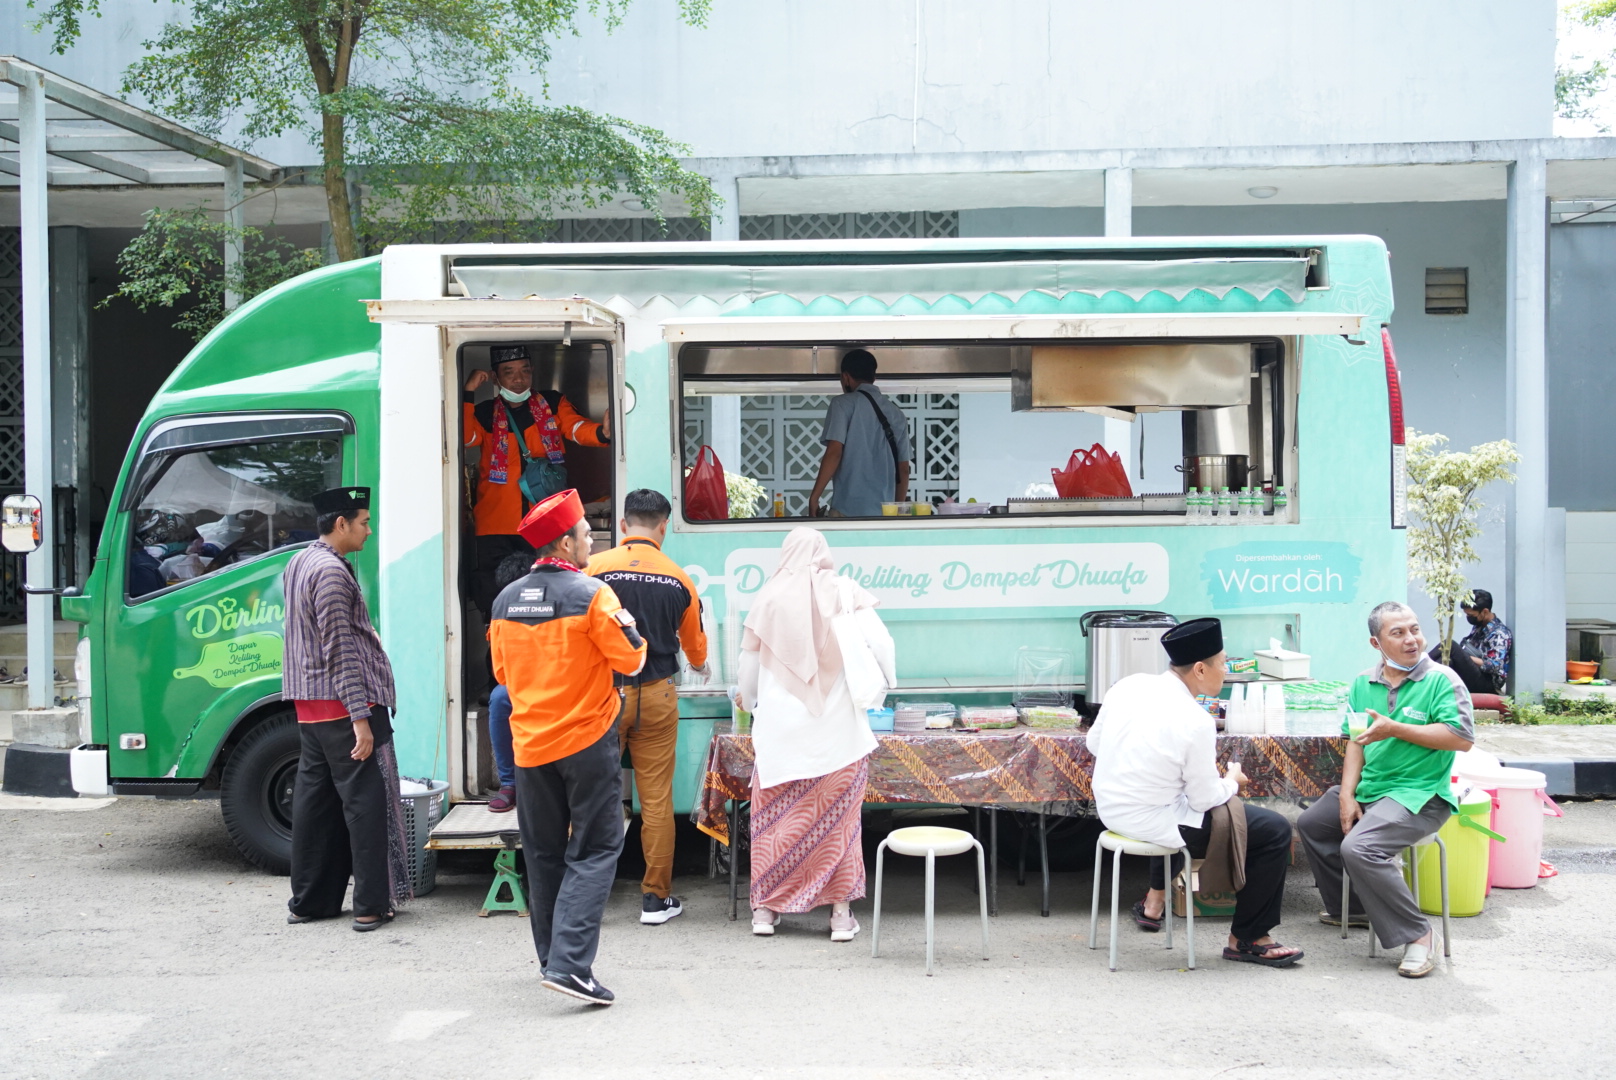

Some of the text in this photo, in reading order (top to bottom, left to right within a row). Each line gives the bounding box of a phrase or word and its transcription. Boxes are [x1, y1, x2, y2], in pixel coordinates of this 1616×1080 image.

[1235, 554, 1301, 563] Dipersembahkan
[604, 573, 682, 590] DOMPET DHUAFA
[939, 560, 1045, 596] Dompet
[1050, 559, 1148, 595] Dhuafa
[531, 605, 554, 613] DHUAFA
[228, 641, 257, 653] Dapur
[229, 653, 261, 664] Keliling
[213, 659, 281, 679] Dompet Dhuafa
